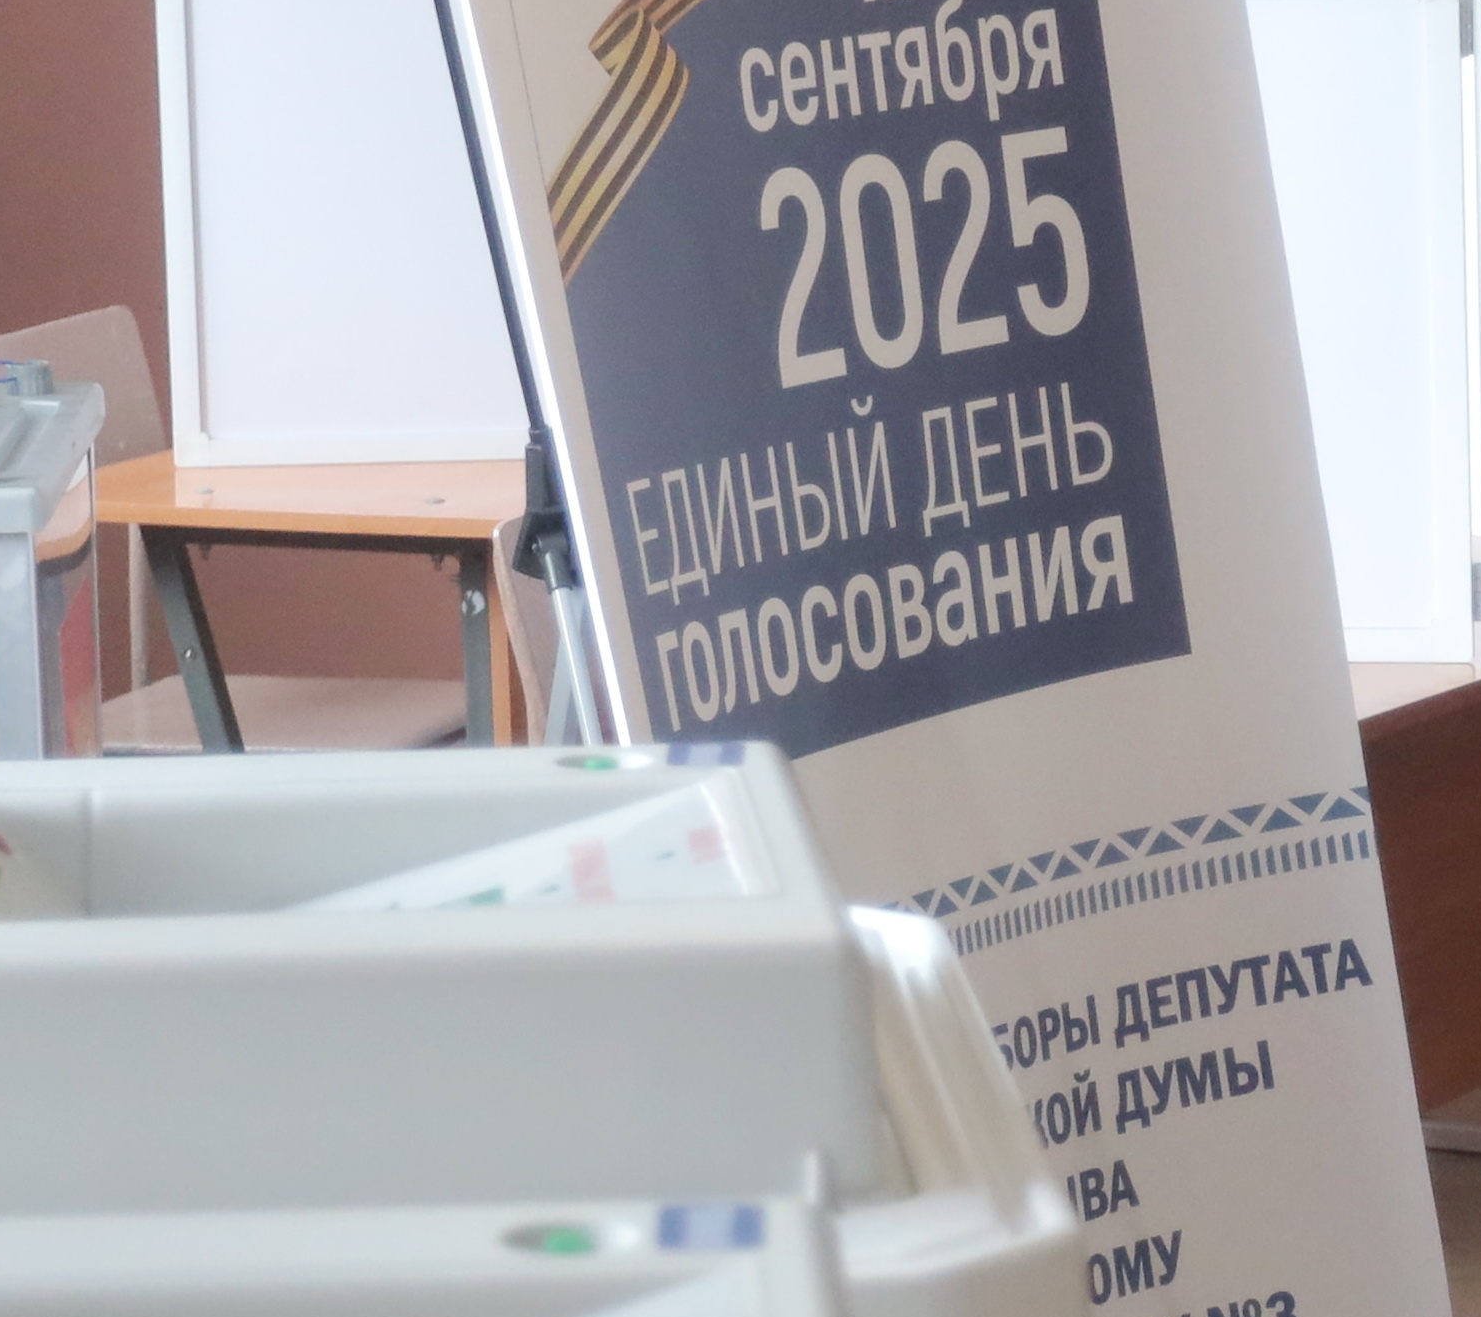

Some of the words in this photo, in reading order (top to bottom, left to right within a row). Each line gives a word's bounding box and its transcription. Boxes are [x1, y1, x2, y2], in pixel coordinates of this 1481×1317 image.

[759, 125, 1092, 390] 2025
[626, 397, 898, 605] ЕДИНЫЙ
[920, 381, 1115, 537] ДЕНЬ
[990, 994, 1101, 1072] БОРЫ
[1114, 937, 1374, 1049] ДЕПУТАТА
[1114, 1039, 1276, 1134] ДУМЫ
